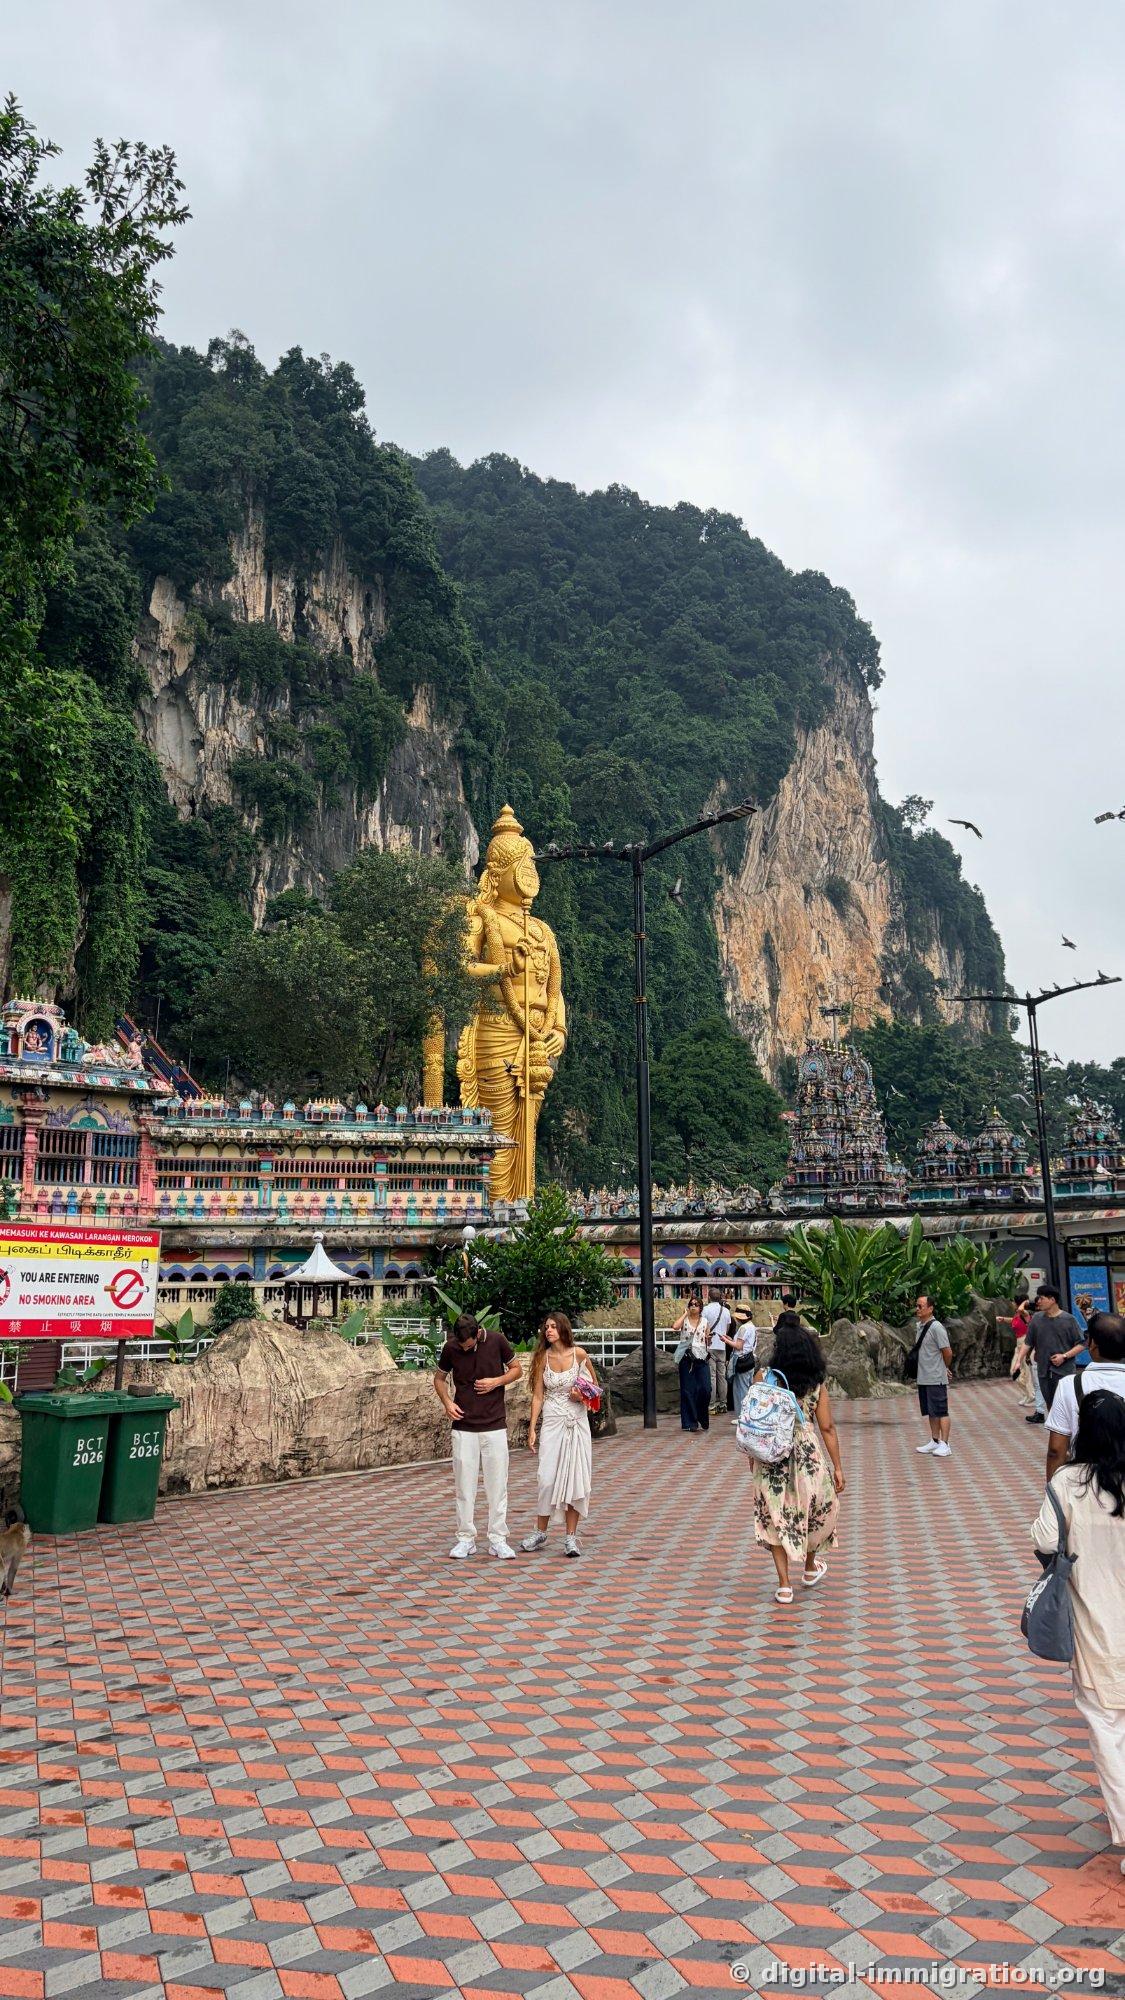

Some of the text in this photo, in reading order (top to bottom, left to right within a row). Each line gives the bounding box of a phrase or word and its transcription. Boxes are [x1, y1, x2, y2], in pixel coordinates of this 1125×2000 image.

[0, 1228, 153, 1243] MEMASUKI KE KAWASAN LARANGAN MEROKOK
[20, 1272, 100, 1284] YOU ARE ENTERING
[18, 1294, 31, 1305] NO
[32, 1294, 71, 1305] SMOKING
[72, 1295, 95, 1305] AREA
[77, 1436, 104, 1451] BCT
[133, 1431, 160, 1445] BCT
[73, 1450, 103, 1466] 2026
[129, 1444, 160, 1459] 2026
